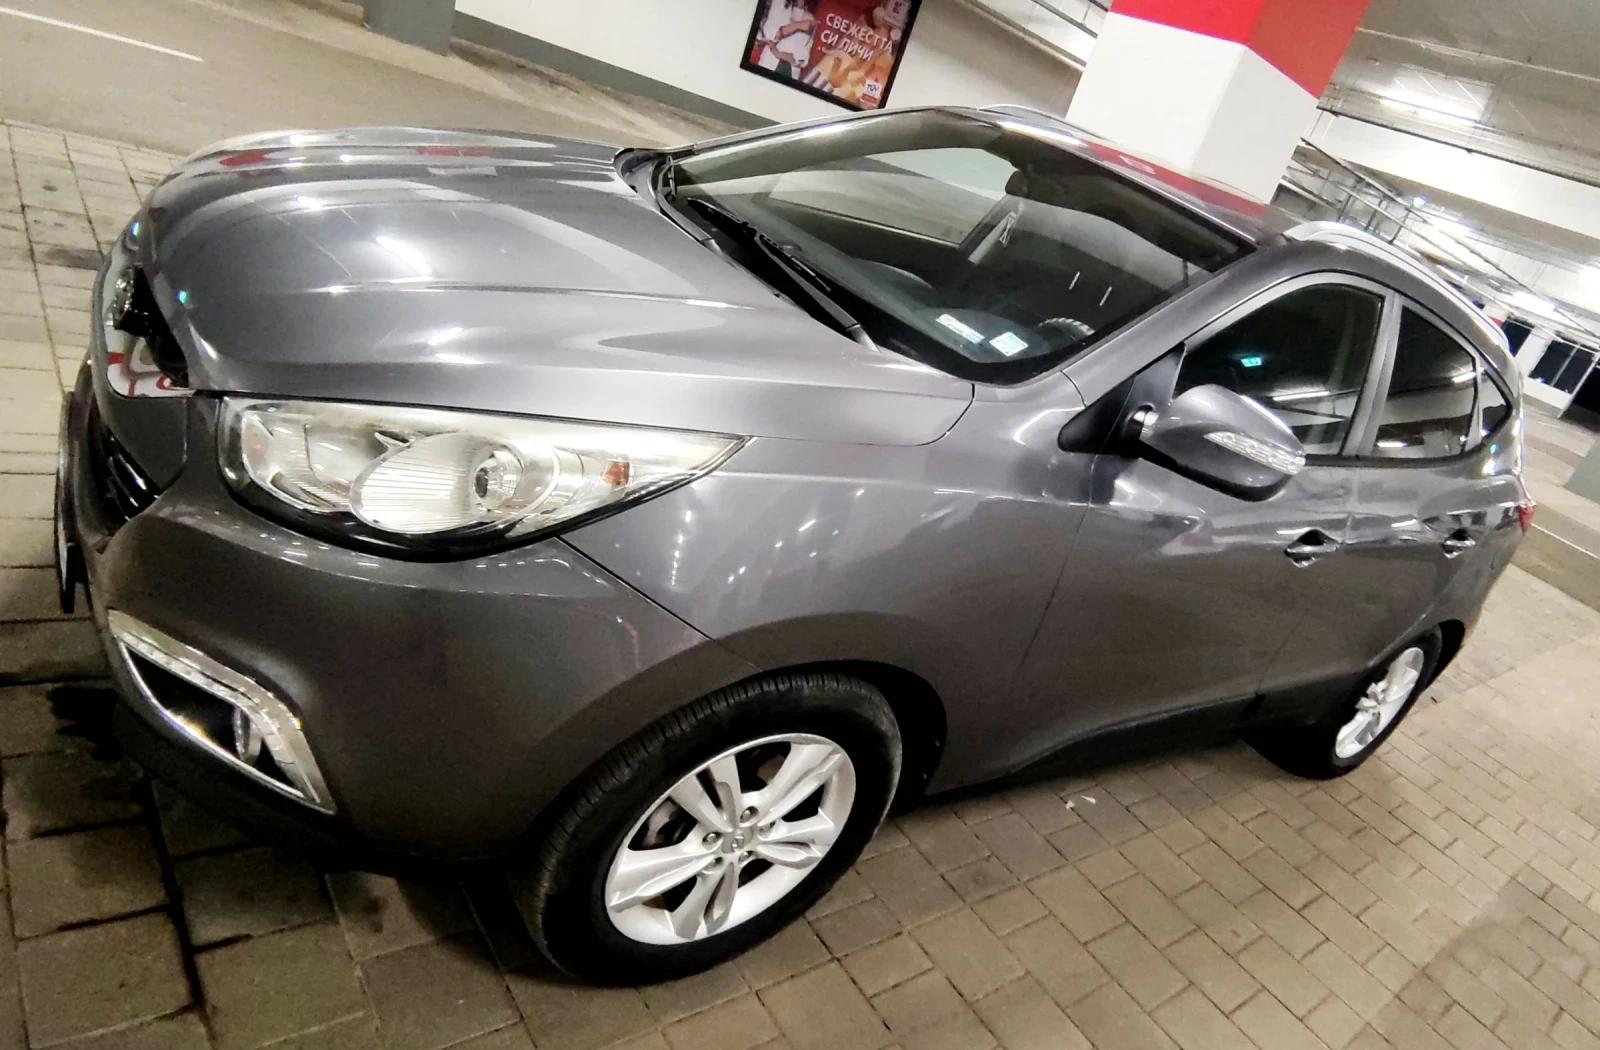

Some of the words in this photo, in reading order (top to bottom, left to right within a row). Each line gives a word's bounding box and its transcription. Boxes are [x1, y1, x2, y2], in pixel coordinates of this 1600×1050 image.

[820, 30, 839, 47] СИ
[840, 37, 873, 61] ЛИЧИ
[826, 13, 893, 54] СВЕЖЕСТТА
